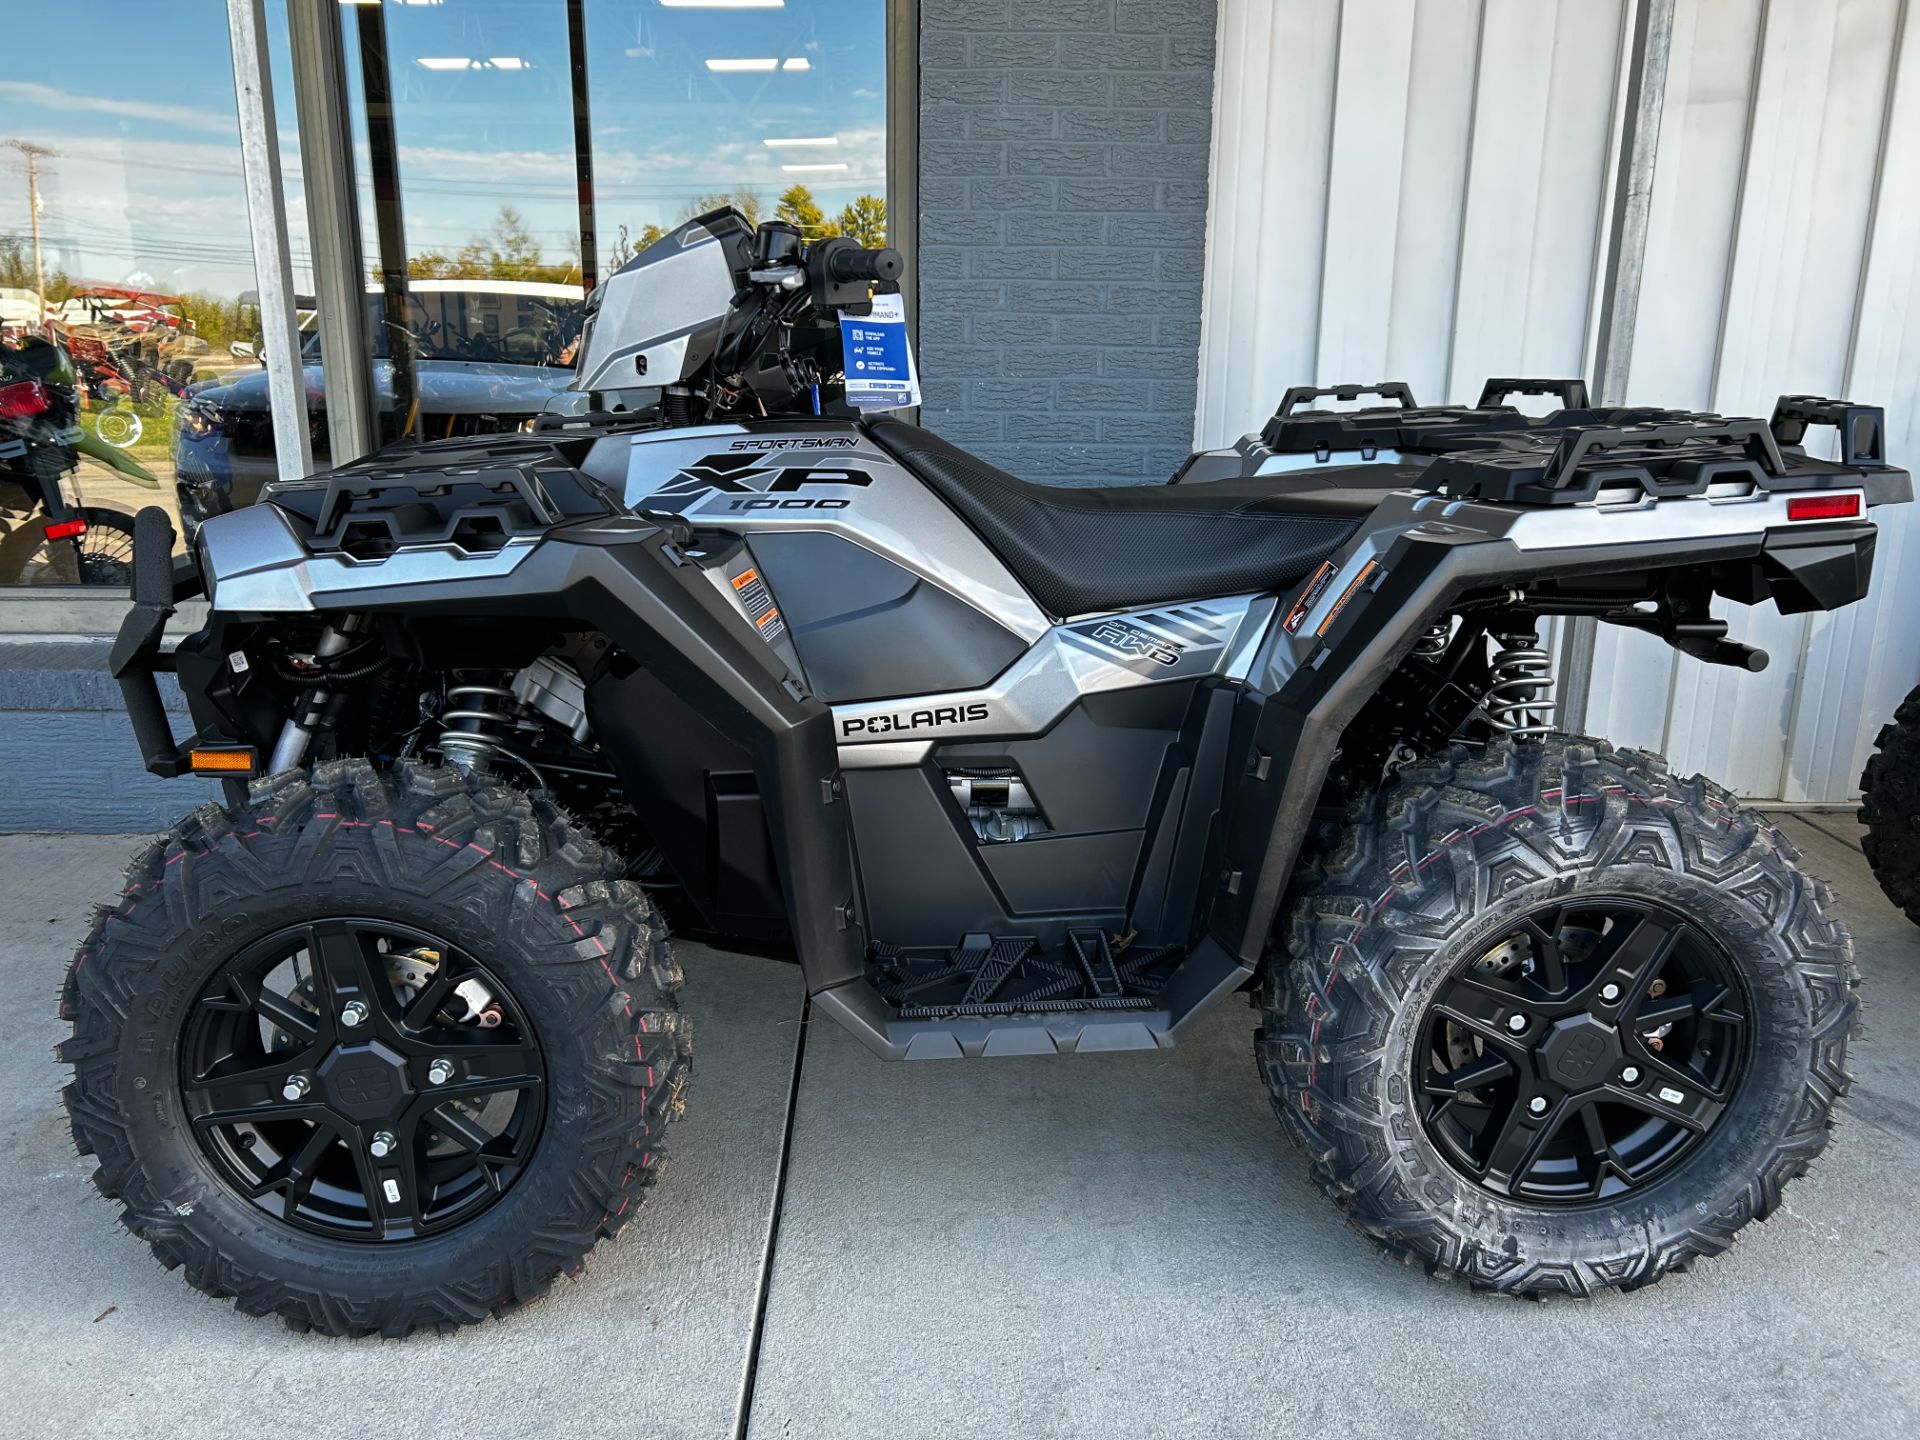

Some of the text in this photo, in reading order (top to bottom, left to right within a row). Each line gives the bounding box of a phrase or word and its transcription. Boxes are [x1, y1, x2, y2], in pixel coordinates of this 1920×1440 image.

[729, 437, 859, 451] SPORTSMAN
[678, 451, 875, 493] XP
[727, 499, 851, 511] 1000
[1091, 624, 1181, 668] AWD
[842, 703, 990, 737] POLARIS
[1386, 1072, 1454, 1207] DURO
